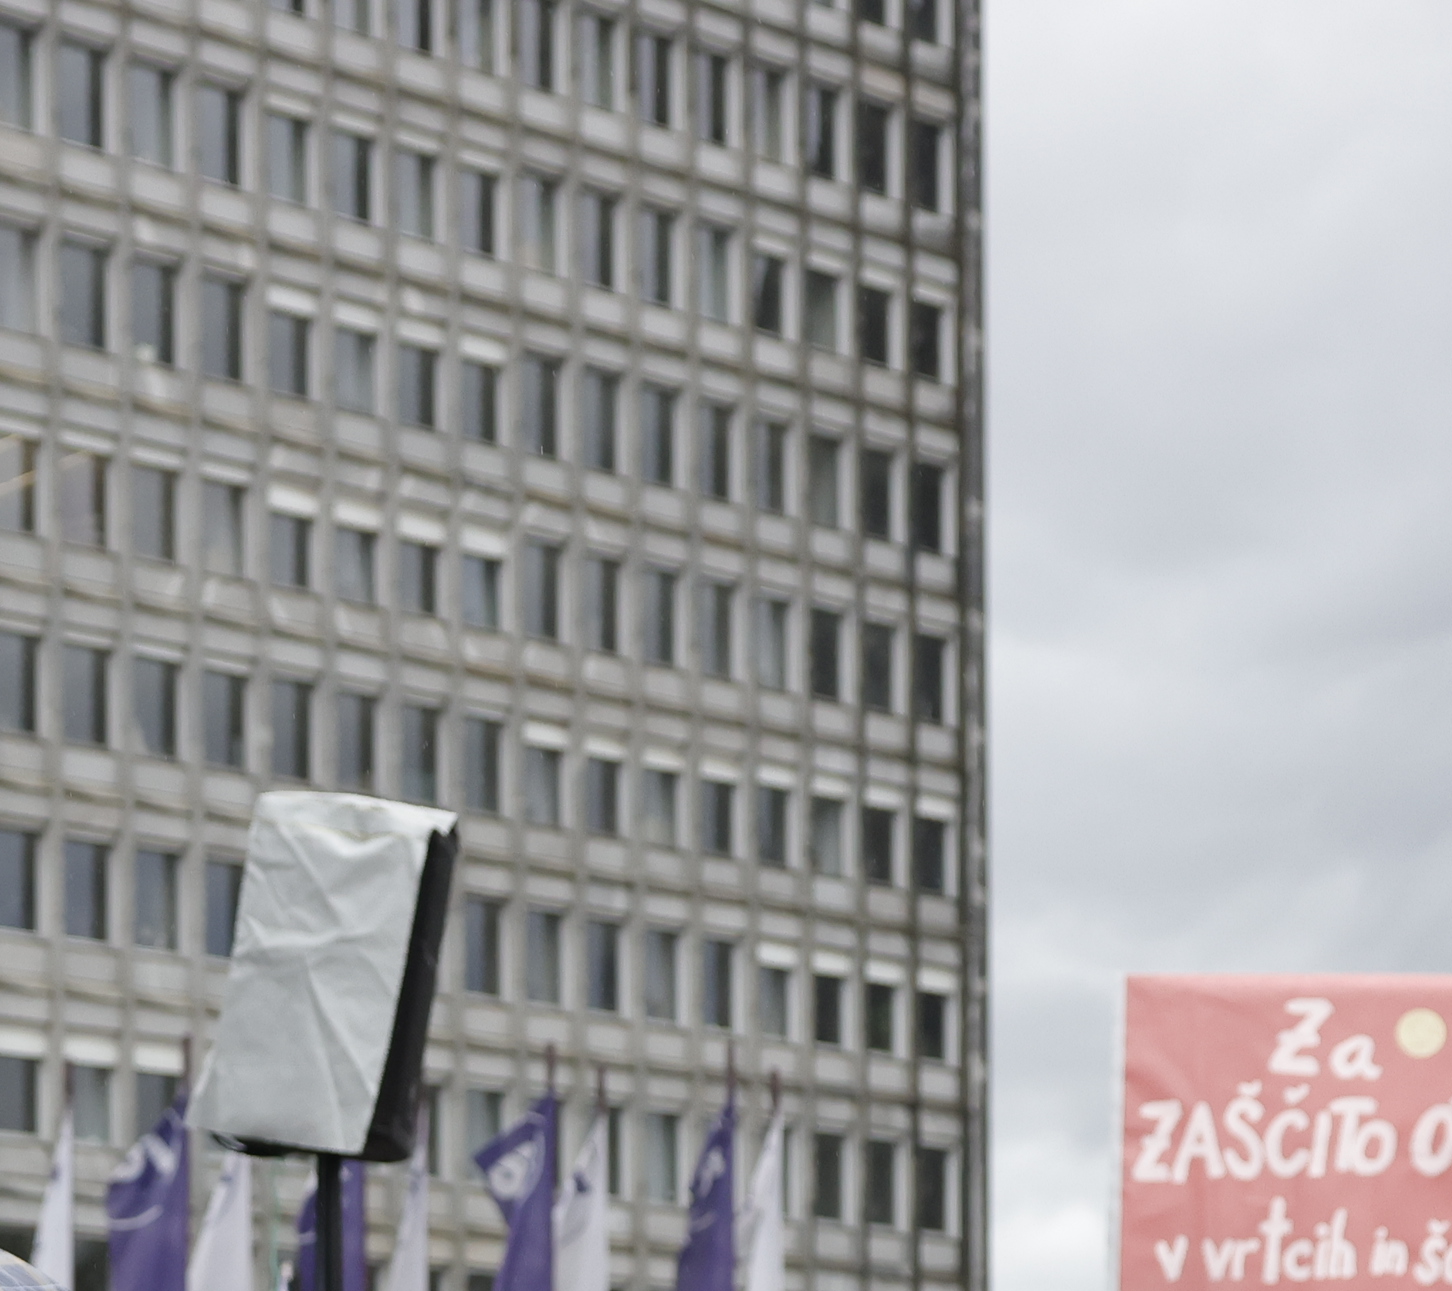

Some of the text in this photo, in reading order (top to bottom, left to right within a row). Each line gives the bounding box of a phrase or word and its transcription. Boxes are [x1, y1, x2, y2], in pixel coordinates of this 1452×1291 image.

[1268, 996, 1382, 1081] Za
[1132, 1080, 1397, 1183] ZAŠČITO
[1154, 1233, 1188, 1283] v
[1202, 1196, 1356, 1286] vrtcih
[1370, 1225, 1407, 1277] in
